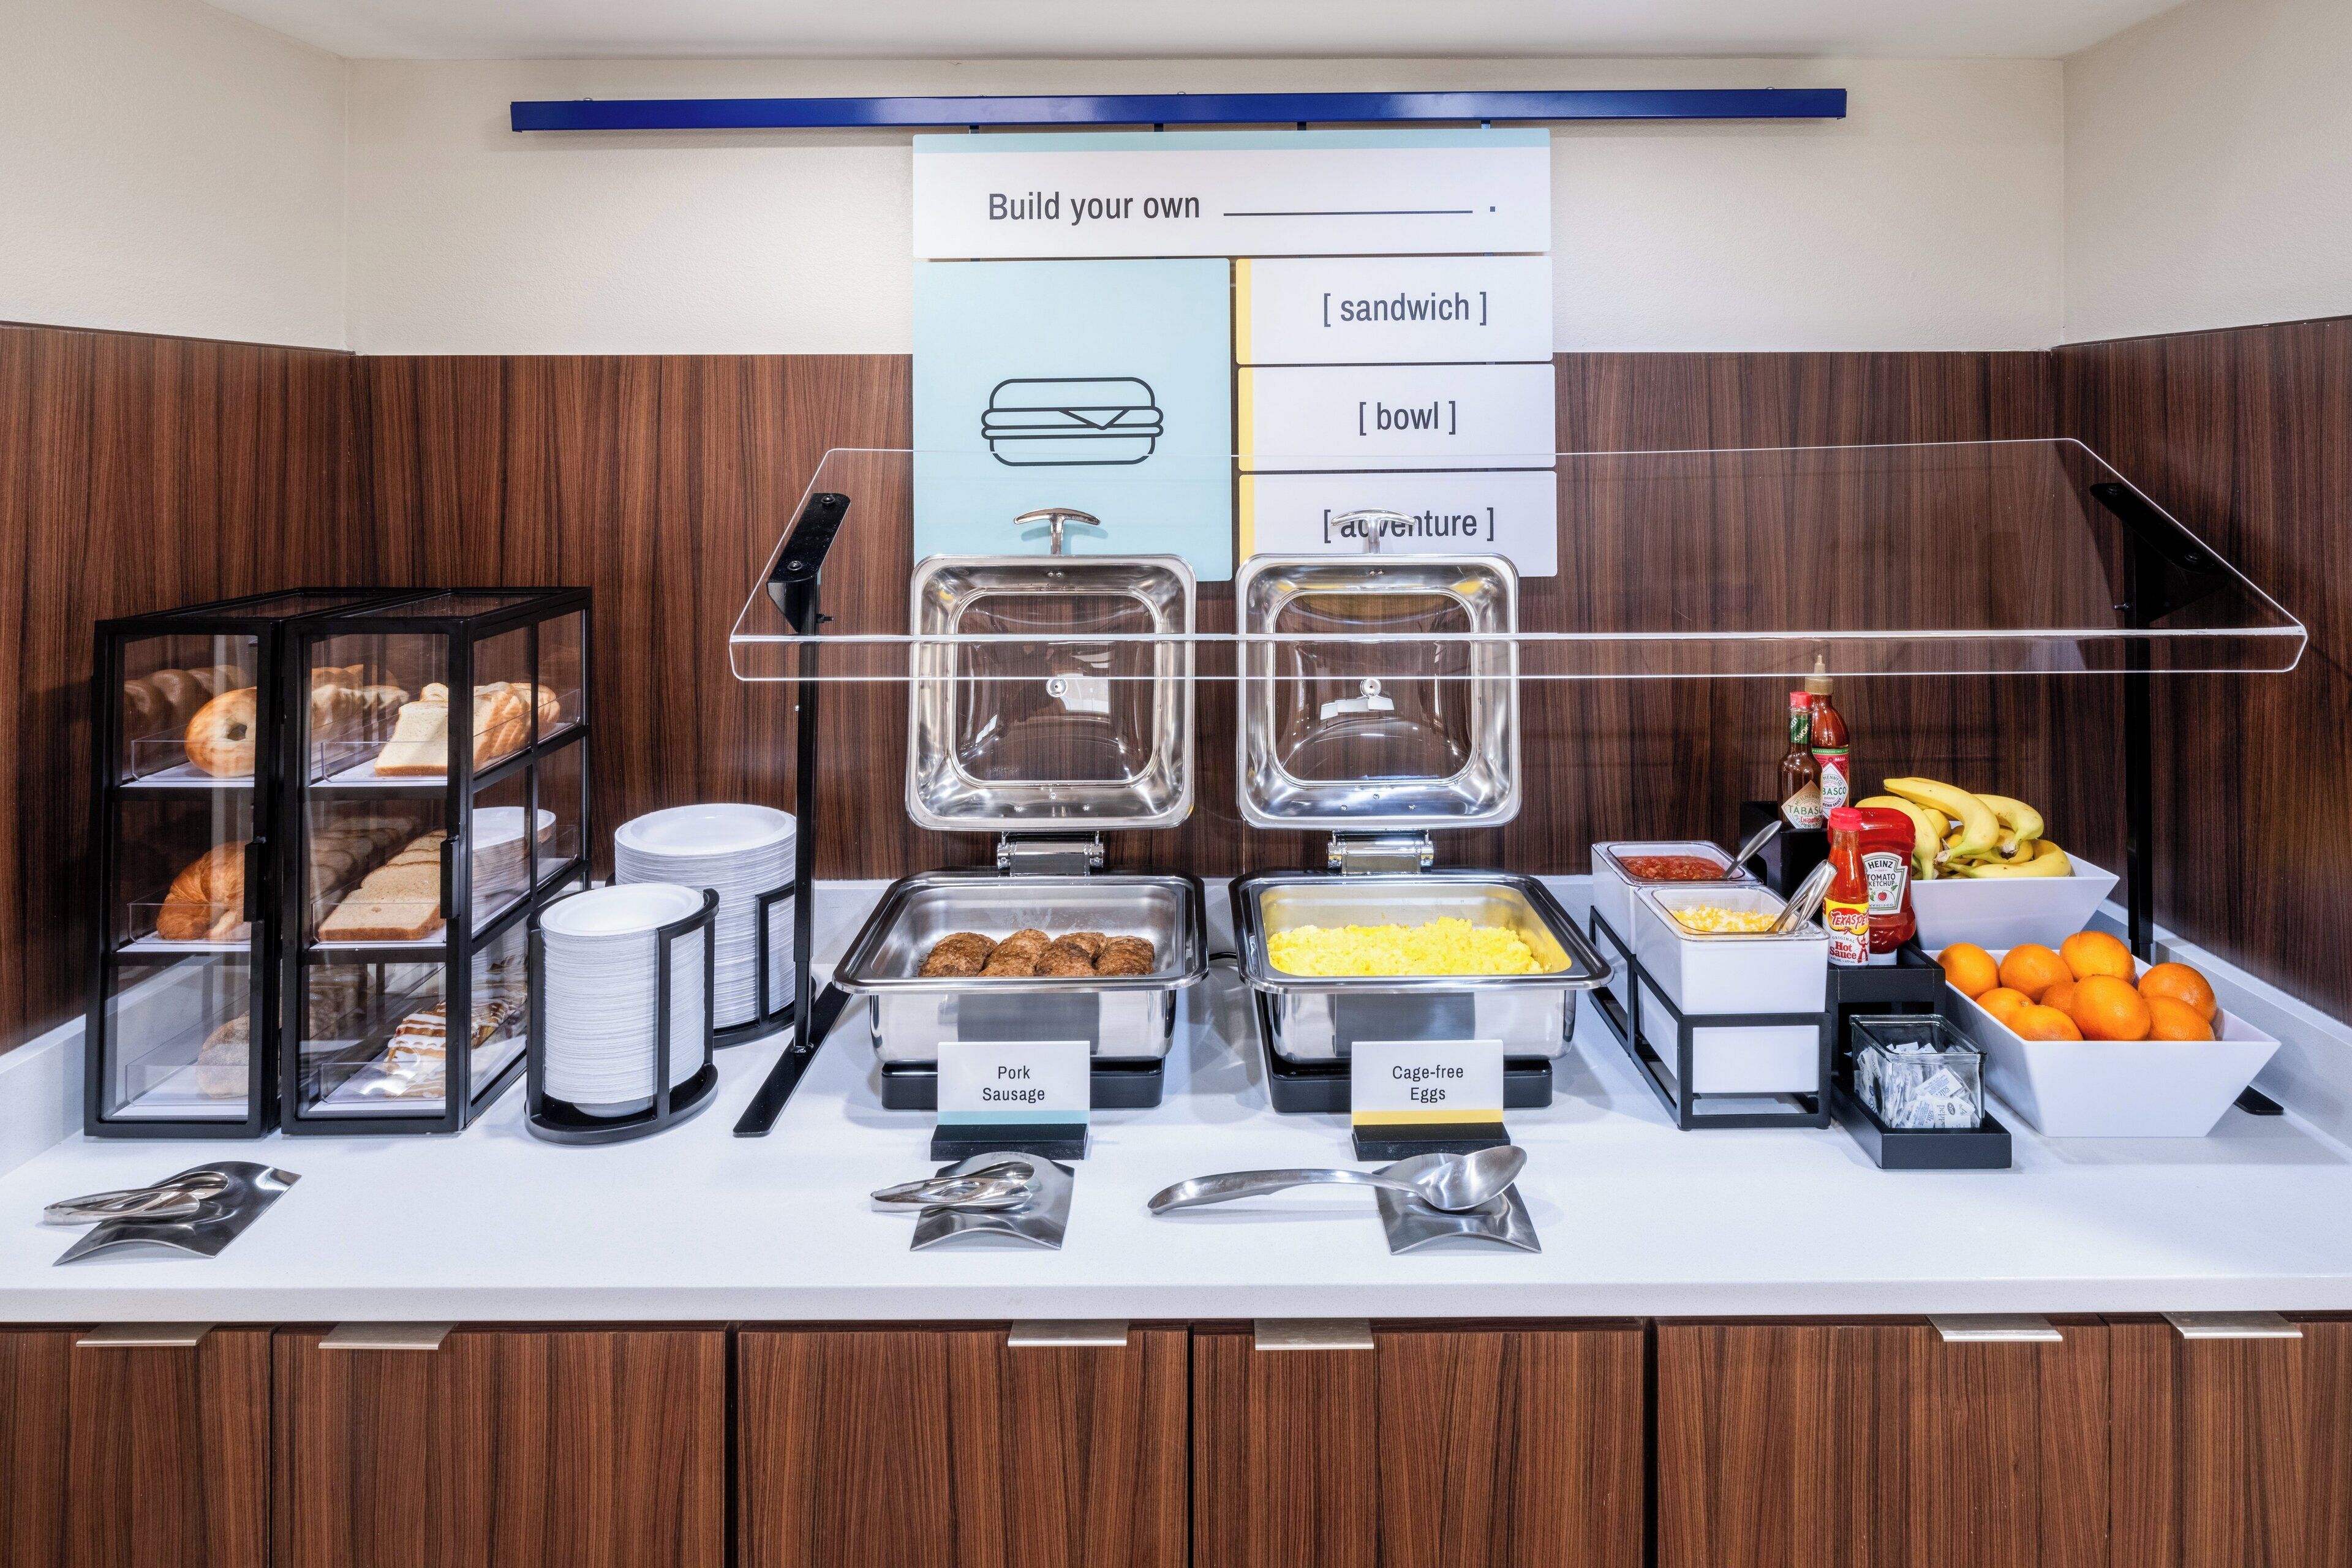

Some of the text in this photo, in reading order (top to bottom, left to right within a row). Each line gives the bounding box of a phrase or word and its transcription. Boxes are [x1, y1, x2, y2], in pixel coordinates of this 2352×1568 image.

[989, 191, 1060, 220] Build
[1070, 197, 1134, 226] your
[1143, 195, 1200, 219] own
[1822, 786, 1847, 796] BASCO
[1868, 860, 1893, 869] HEINZ
[1867, 873, 1896, 881] TOMATO
[1830, 946, 1856, 959] Sauce
[1835, 941, 1853, 952] Hot
[998, 1065, 1031, 1079] Pork
[1392, 1065, 1464, 1082] Cage-free
[982, 1087, 1045, 1104] Sausage
[1411, 1087, 1446, 1104] Eggs
